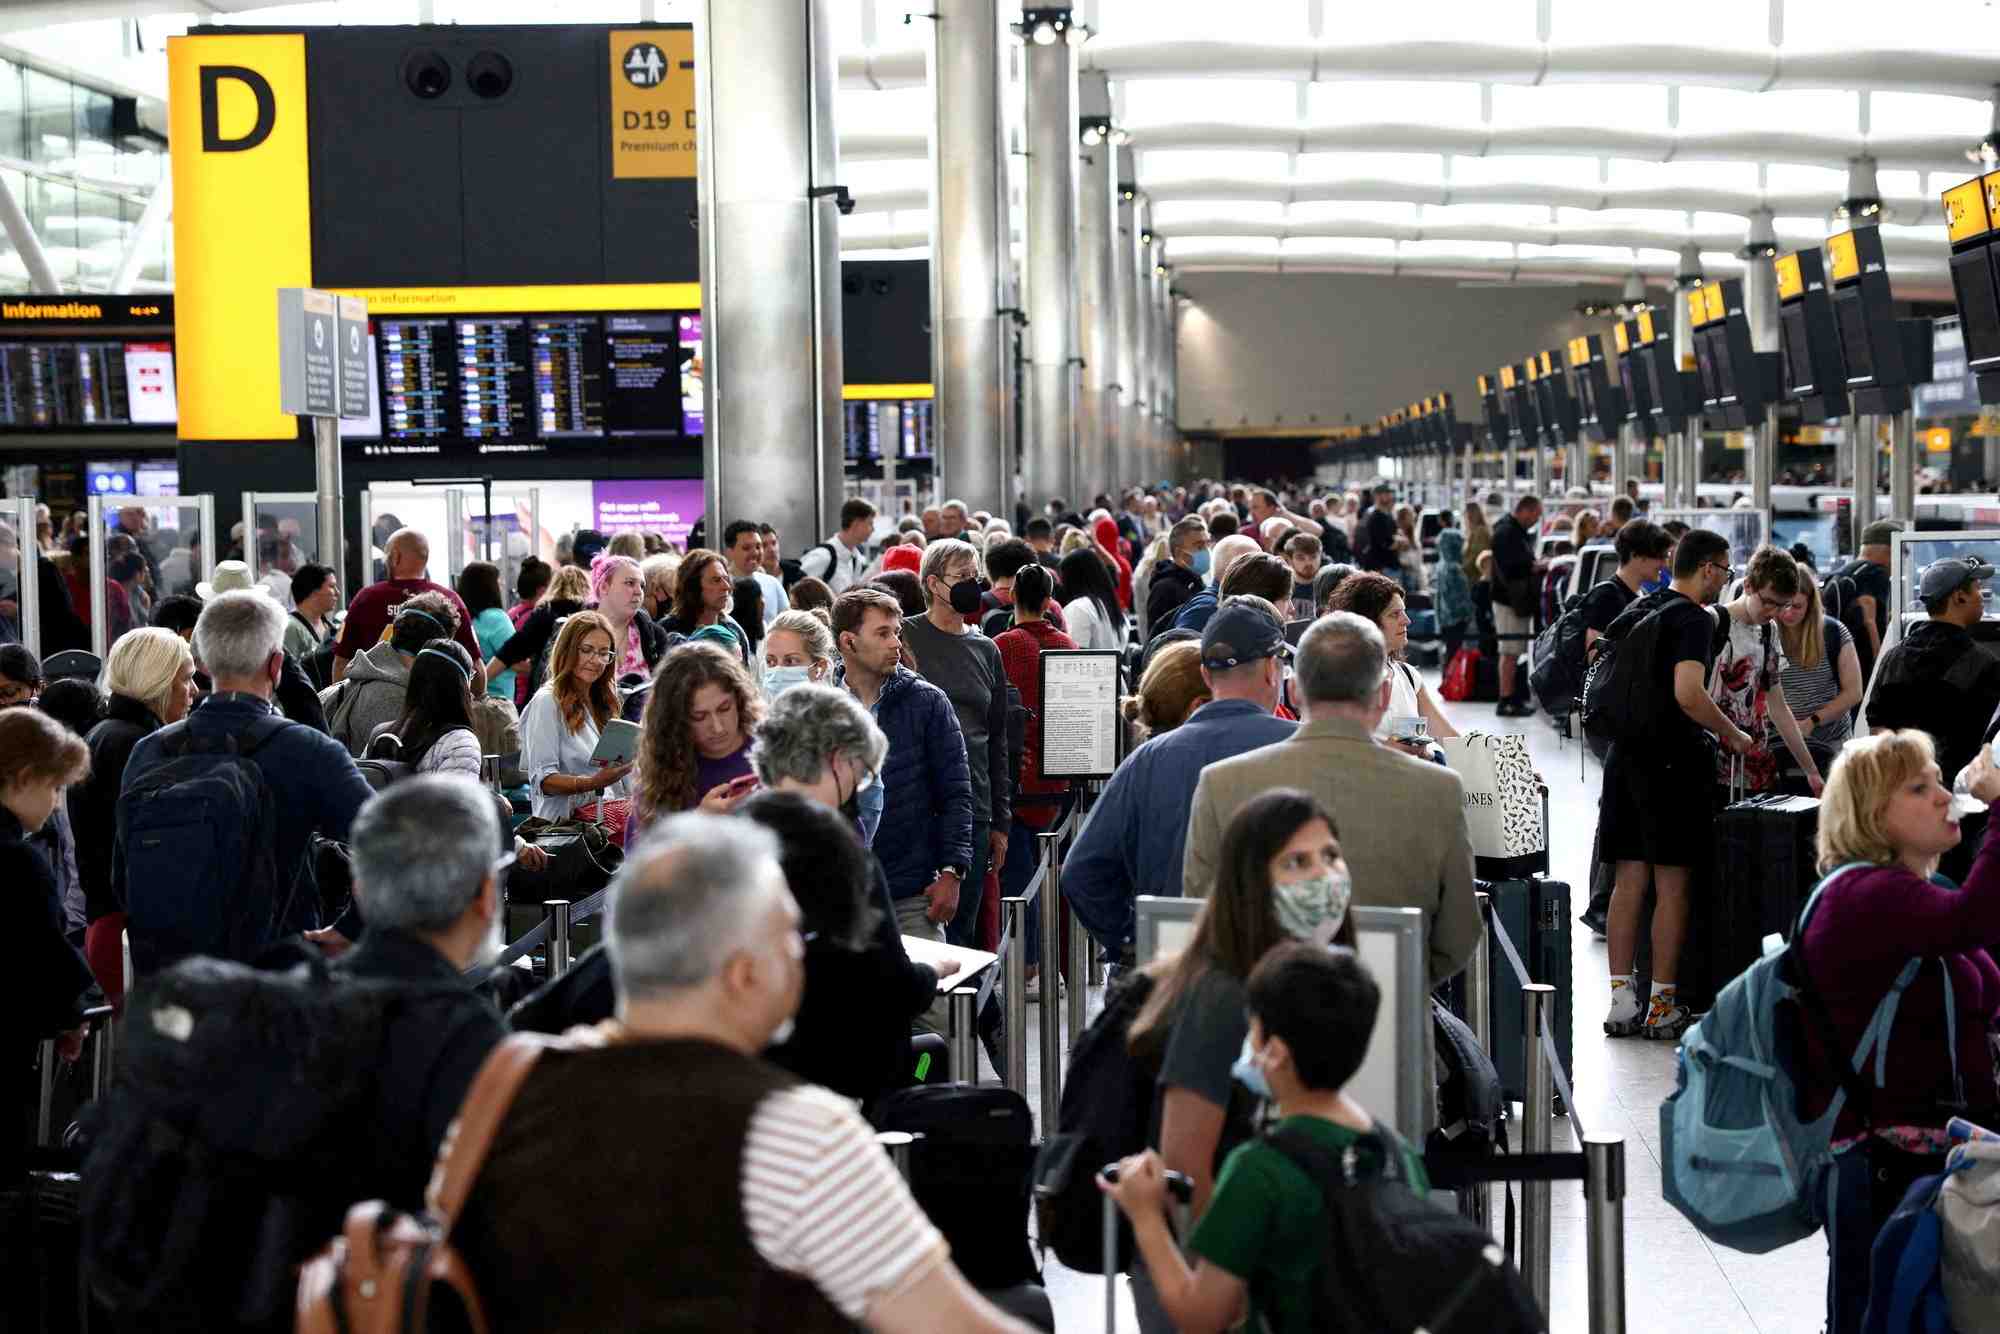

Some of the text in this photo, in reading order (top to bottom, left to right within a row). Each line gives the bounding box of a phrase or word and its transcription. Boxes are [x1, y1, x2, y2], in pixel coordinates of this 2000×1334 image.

[199, 65, 276, 152] D
[623, 110, 671, 131] D19
[620, 141, 679, 153] Premium
